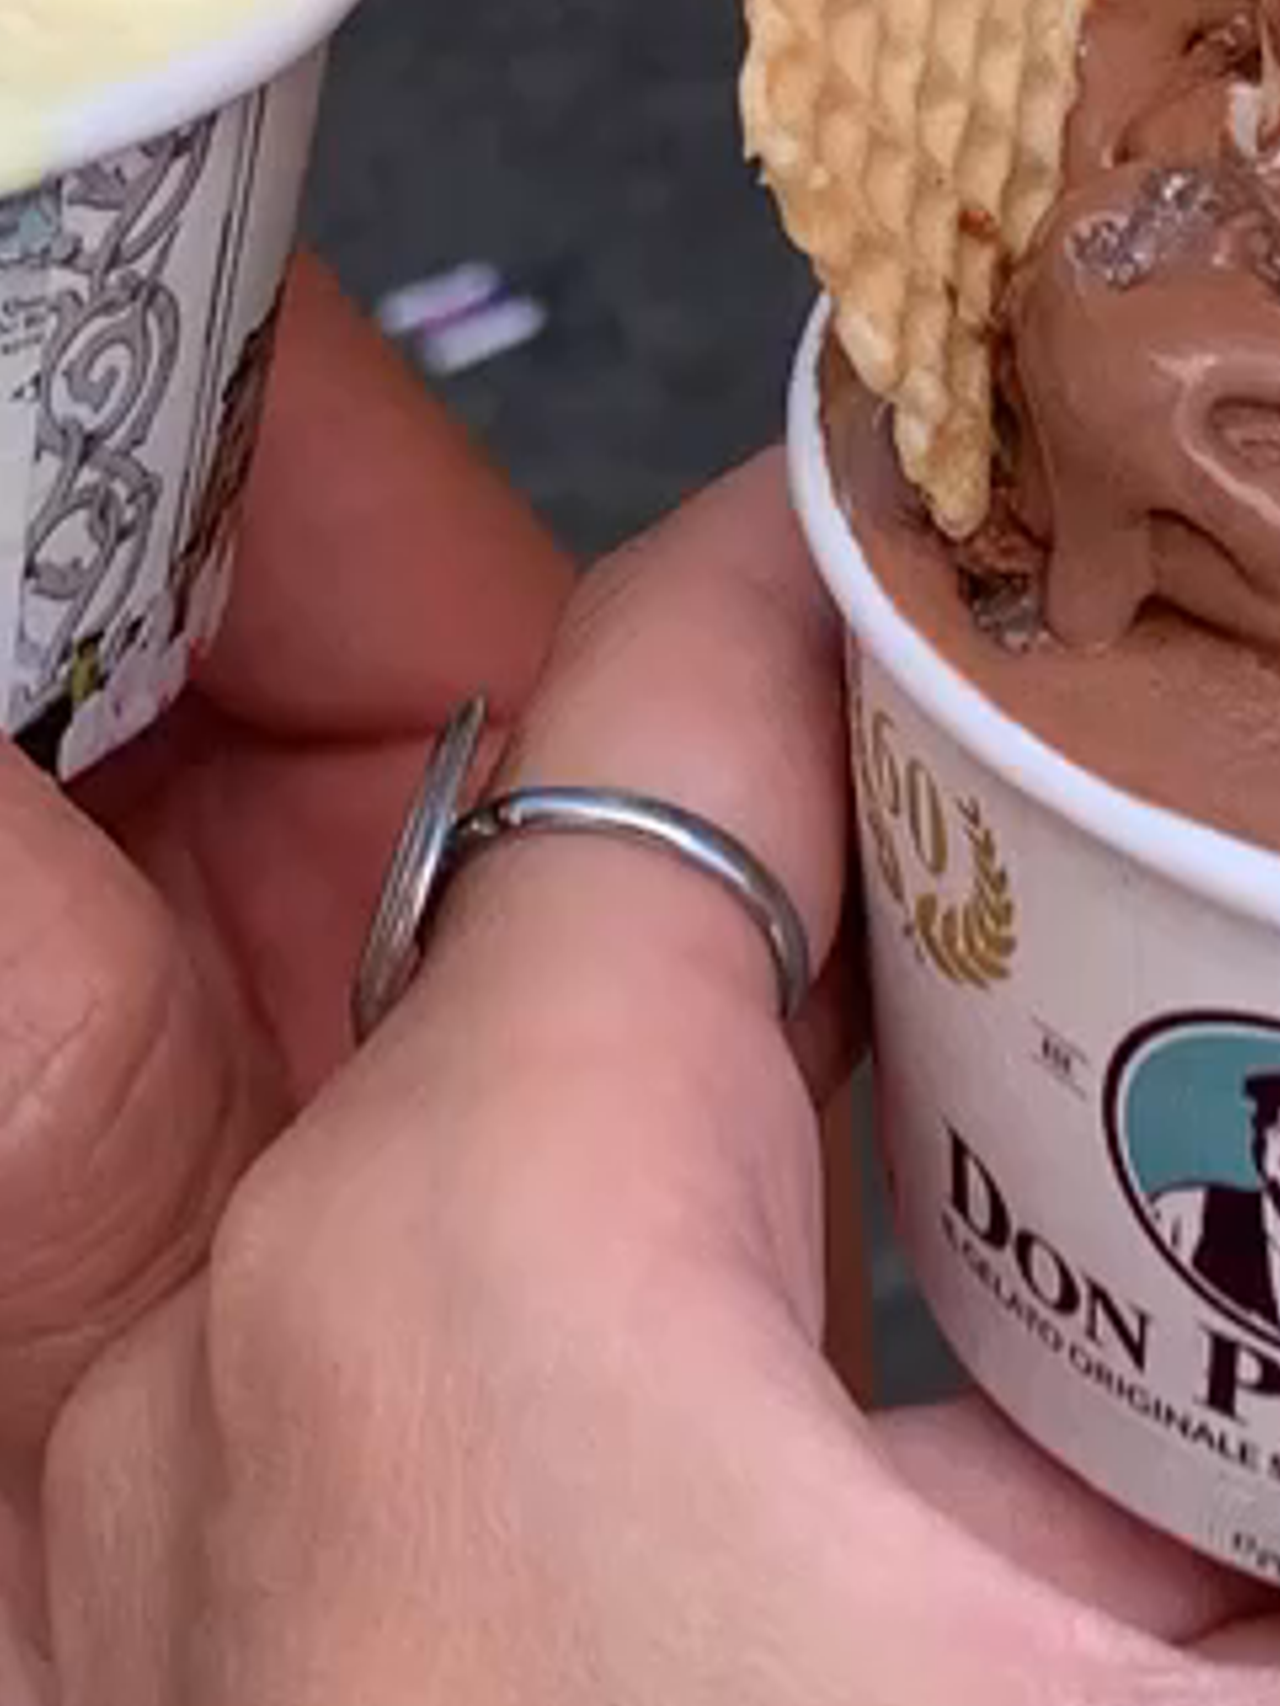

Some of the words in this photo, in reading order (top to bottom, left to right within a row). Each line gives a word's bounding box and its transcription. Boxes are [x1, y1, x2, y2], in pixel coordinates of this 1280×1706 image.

[946, 1126, 1152, 1376] DON
[960, 1236, 1065, 1354] GELATO
[1068, 1340, 1263, 1473] ORIGINALE
